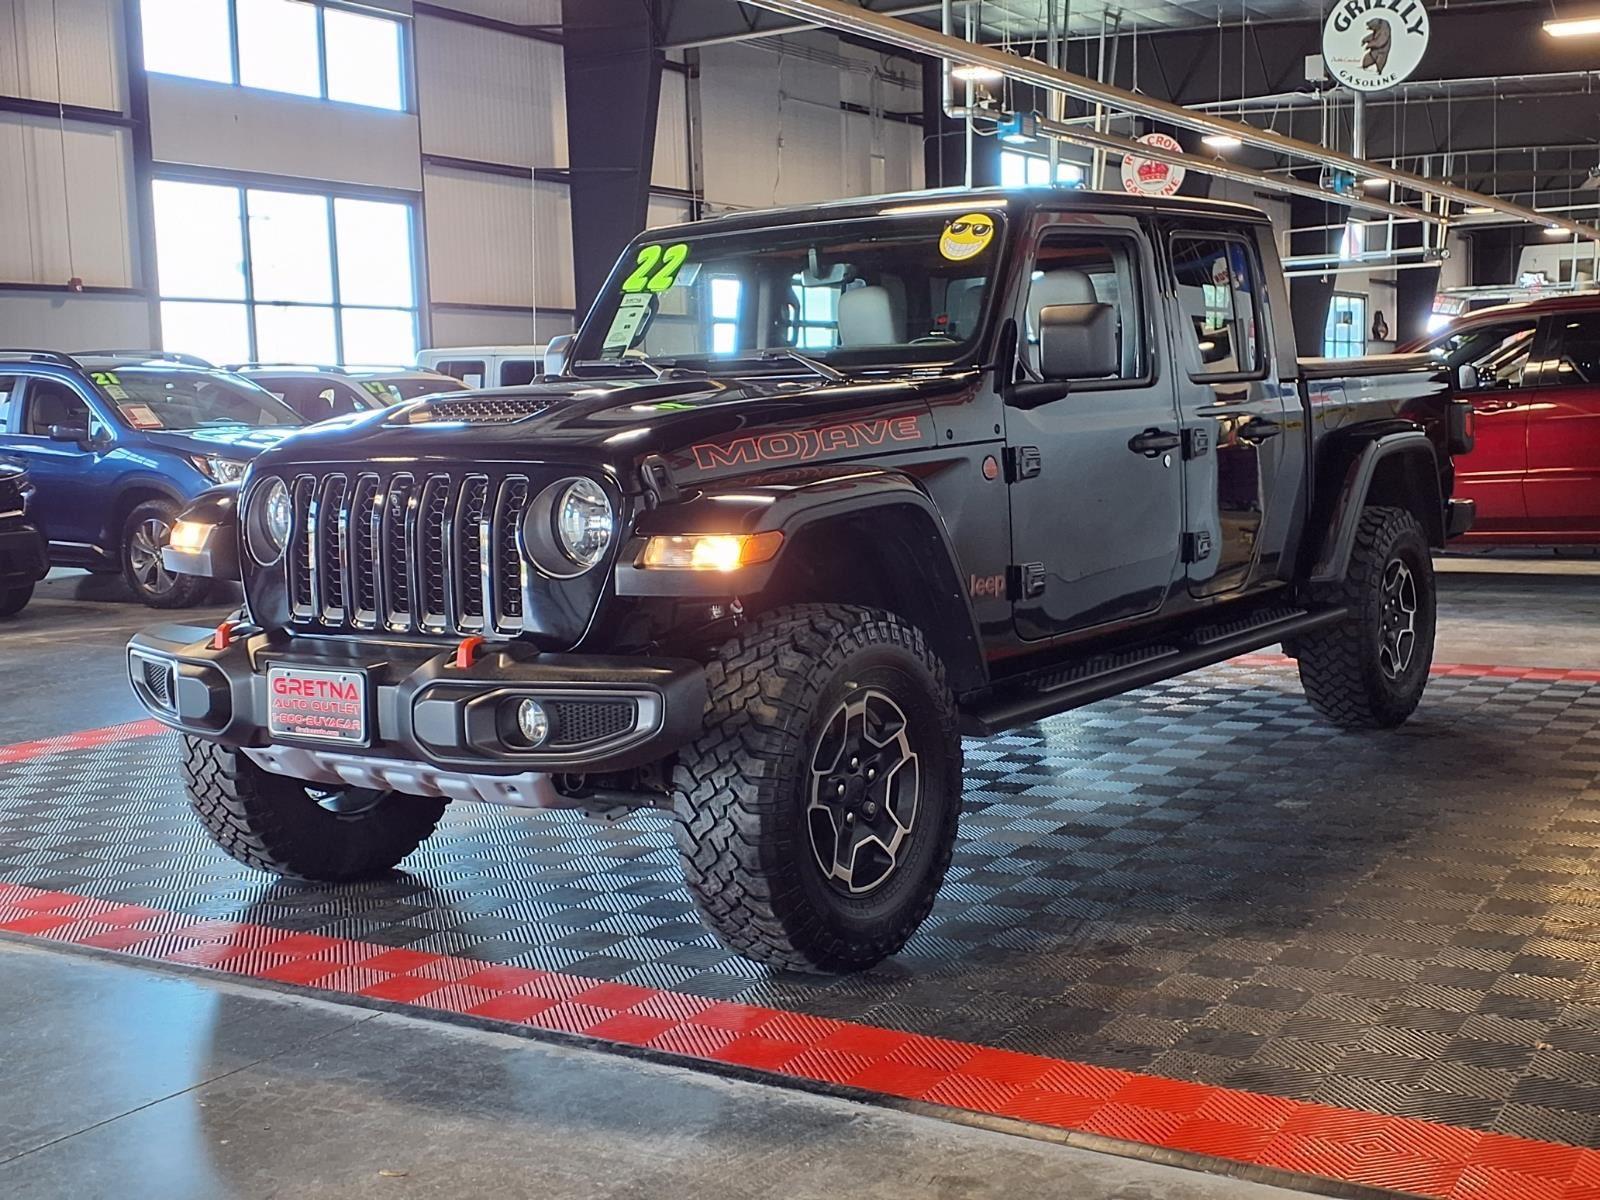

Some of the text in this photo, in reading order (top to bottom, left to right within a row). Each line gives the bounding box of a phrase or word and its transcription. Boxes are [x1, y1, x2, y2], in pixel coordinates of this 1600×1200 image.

[1339, 70, 1398, 87] GASOLINE
[1147, 136, 1179, 153] CRO
[1125, 177, 1180, 196] GAINE
[622, 243, 688, 292] 22
[90, 372, 120, 385] 21
[692, 416, 921, 470] MOJAVE
[970, 574, 1006, 598] Jeep
[273, 677, 359, 701] GRETNA
[272, 698, 361, 716] AUTO OUTLET
